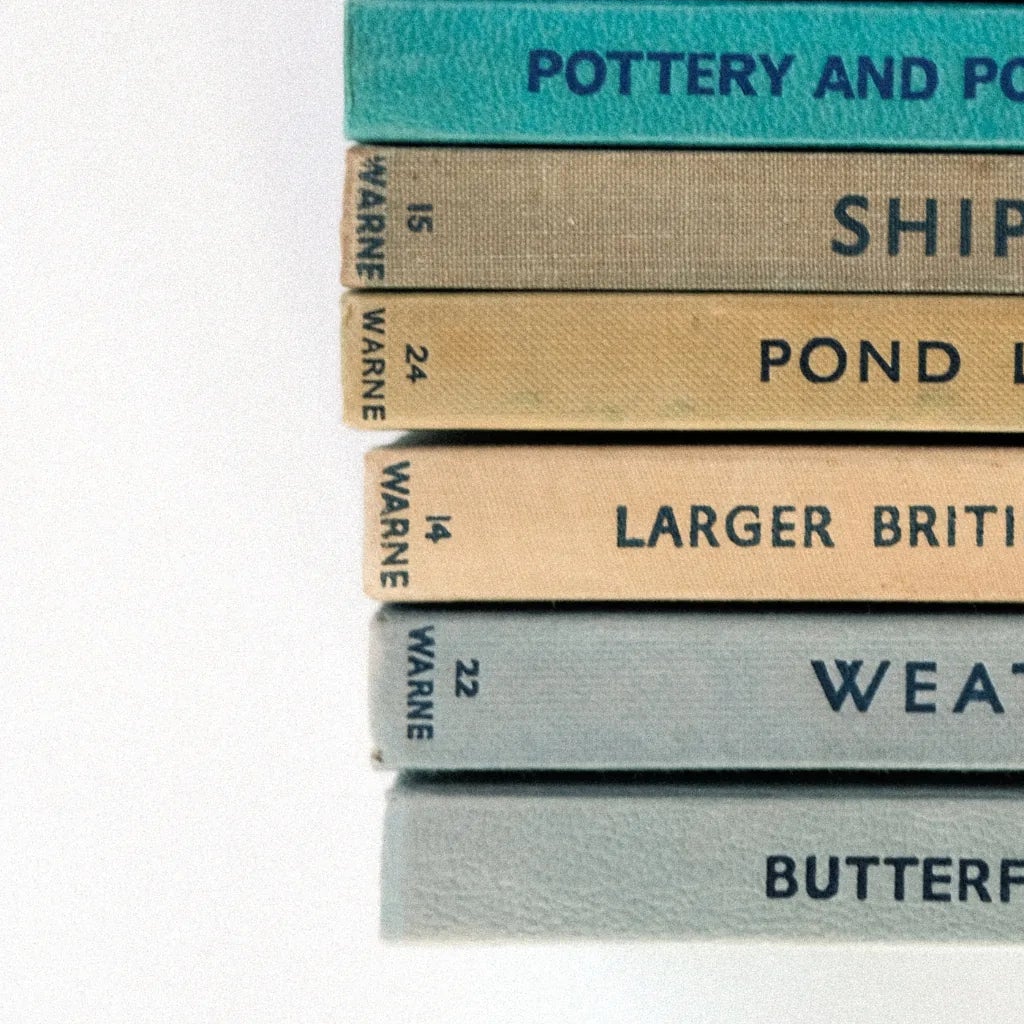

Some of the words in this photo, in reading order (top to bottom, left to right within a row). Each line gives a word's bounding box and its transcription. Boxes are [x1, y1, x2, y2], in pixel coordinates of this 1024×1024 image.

[528, 47, 799, 97] POTTERY
[814, 56, 939, 101] AND
[355, 155, 388, 281] WARNE
[406, 202, 434, 234] 15
[361, 307, 387, 421] WARNE
[405, 343, 429, 384] 24
[760, 338, 960, 385] POND
[379, 460, 411, 589] WARNE
[424, 515, 452, 544] 14
[615, 502, 832, 549] LARGER
[407, 625, 436, 741] WARNE
[454, 658, 480, 699] 22
